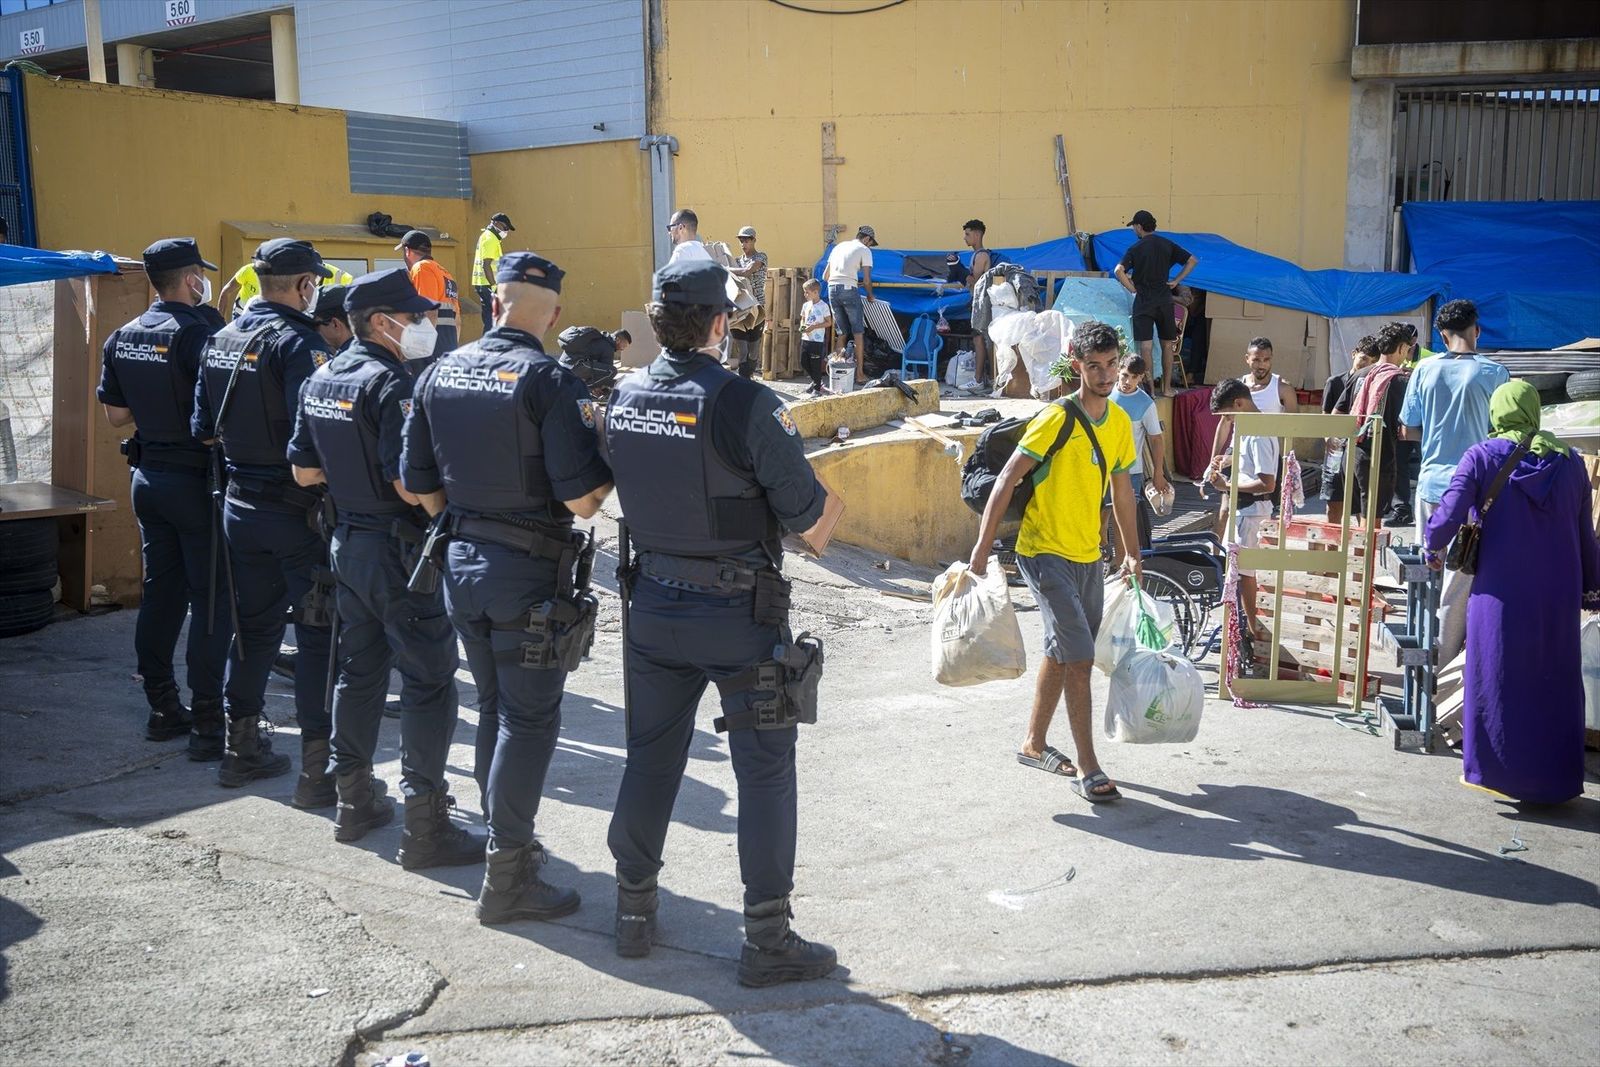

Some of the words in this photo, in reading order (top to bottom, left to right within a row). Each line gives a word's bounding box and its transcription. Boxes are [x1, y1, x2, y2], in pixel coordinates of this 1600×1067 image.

[116, 341, 157, 353] POLICIA
[115, 350, 168, 363] NACIONAL
[438, 365, 499, 381] POLICIA
[434, 376, 514, 394] NACIONAL
[610, 405, 677, 424] POLICIA
[610, 418, 696, 439] NACIONAL
